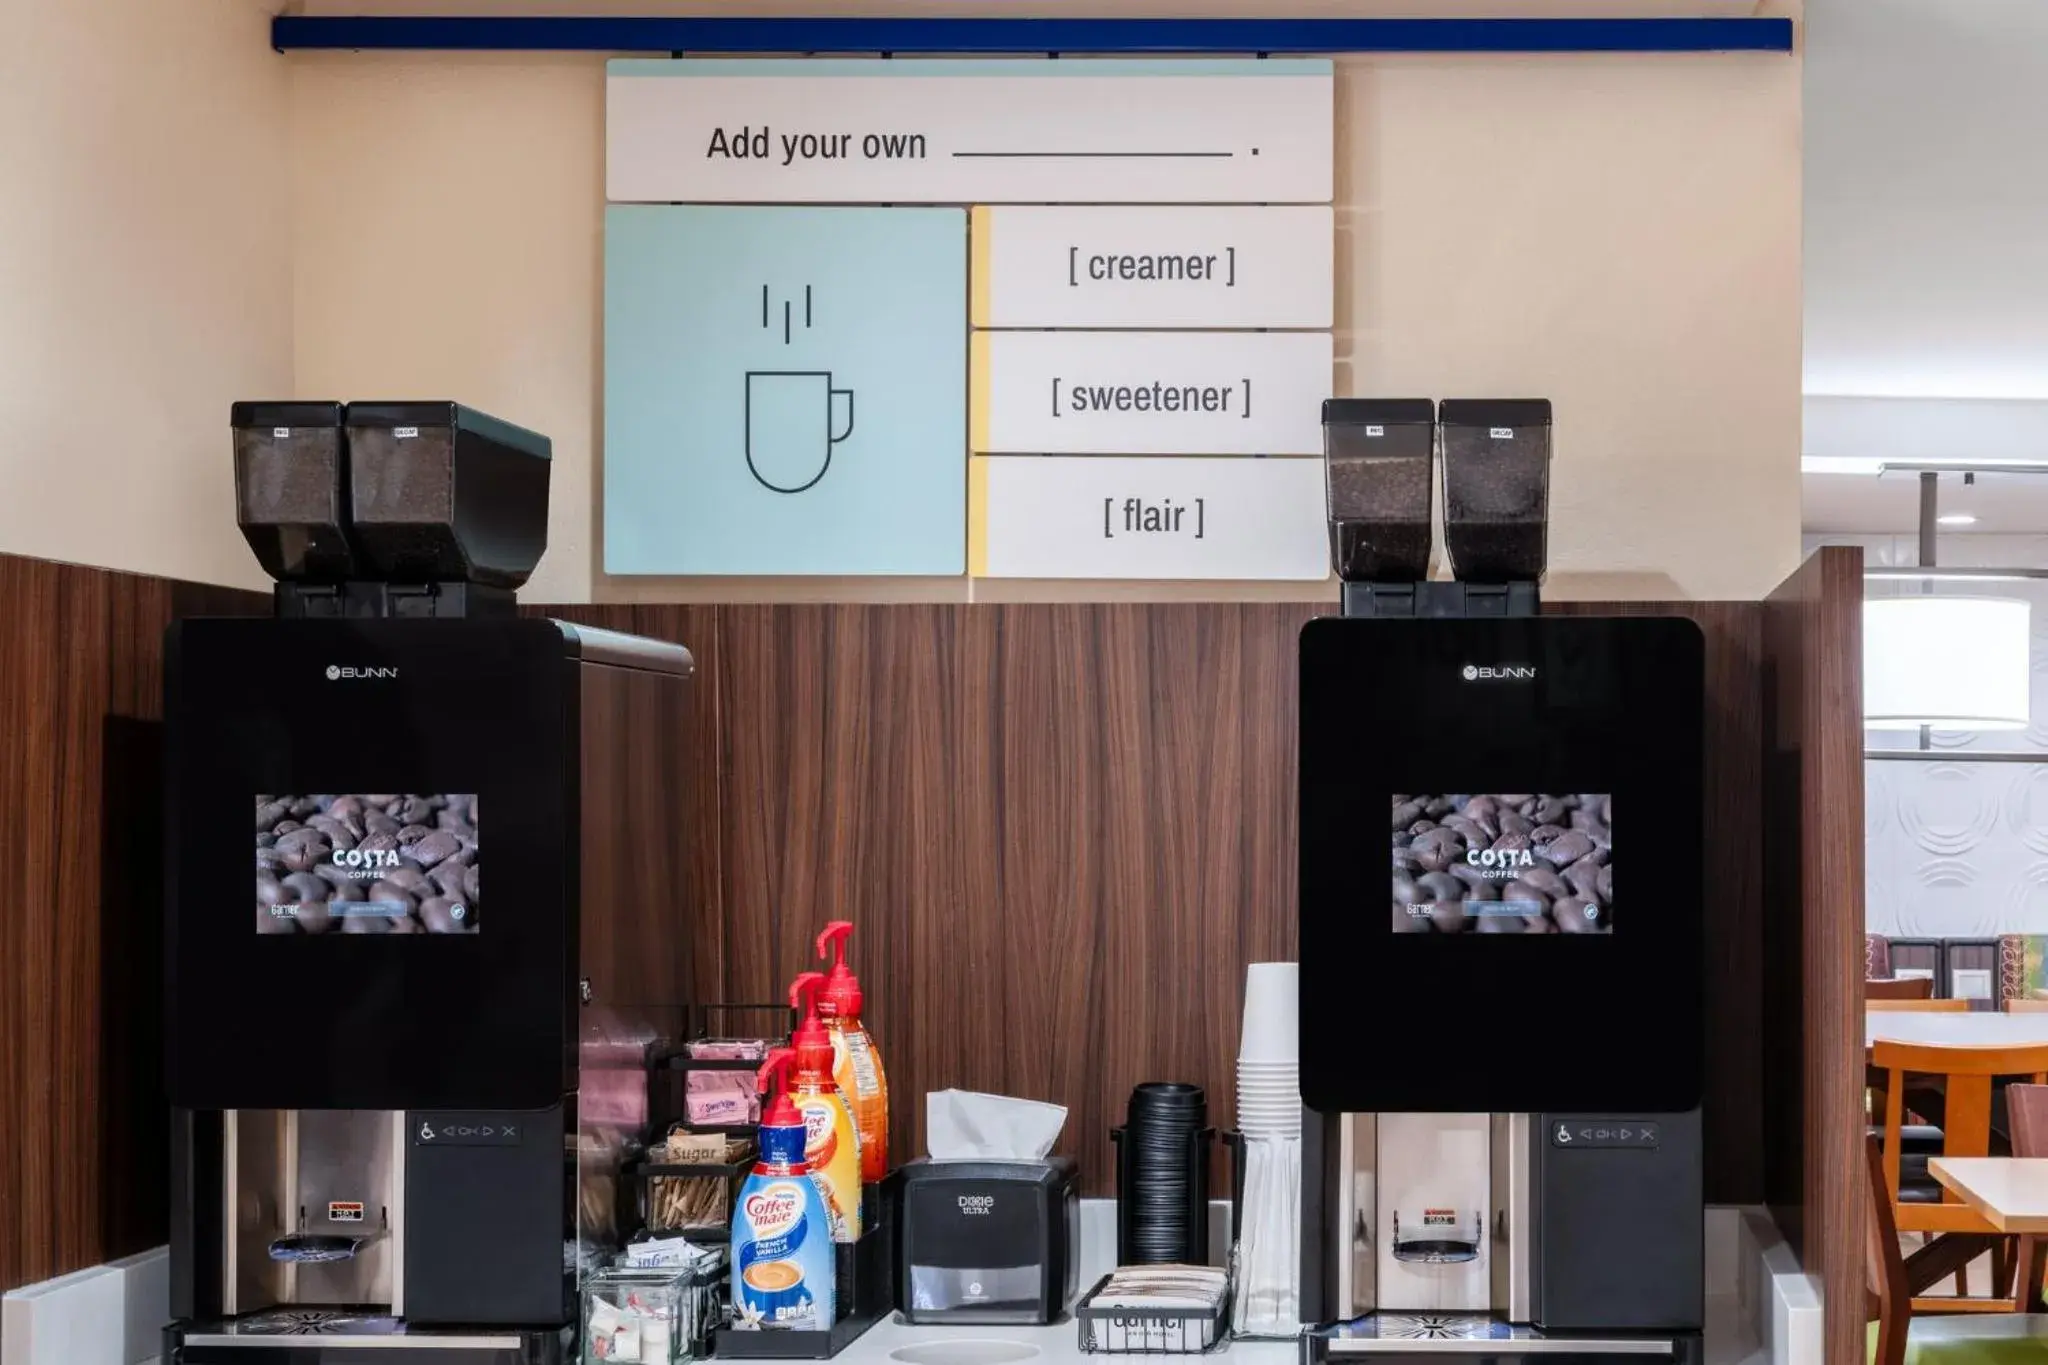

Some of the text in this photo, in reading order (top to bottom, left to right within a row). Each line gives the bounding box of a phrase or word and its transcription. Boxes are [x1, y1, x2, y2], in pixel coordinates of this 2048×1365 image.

[706, 126, 926, 167] Add your own
[1088, 255, 1217, 281] creamer
[1071, 382, 1232, 412] sweetener
[1123, 498, 1185, 533] flair
[341, 666, 396, 679] BUNN
[1479, 666, 1534, 679] BUNN
[332, 849, 400, 869] COSTA
[1467, 848, 1534, 868] COSTA
[347, 871, 386, 879] COFFEE
[1481, 870, 1520, 879] COFFEE
[673, 1148, 716, 1162] Sugar
[747, 1195, 794, 1217] Coffee
[755, 1211, 790, 1226] mate
